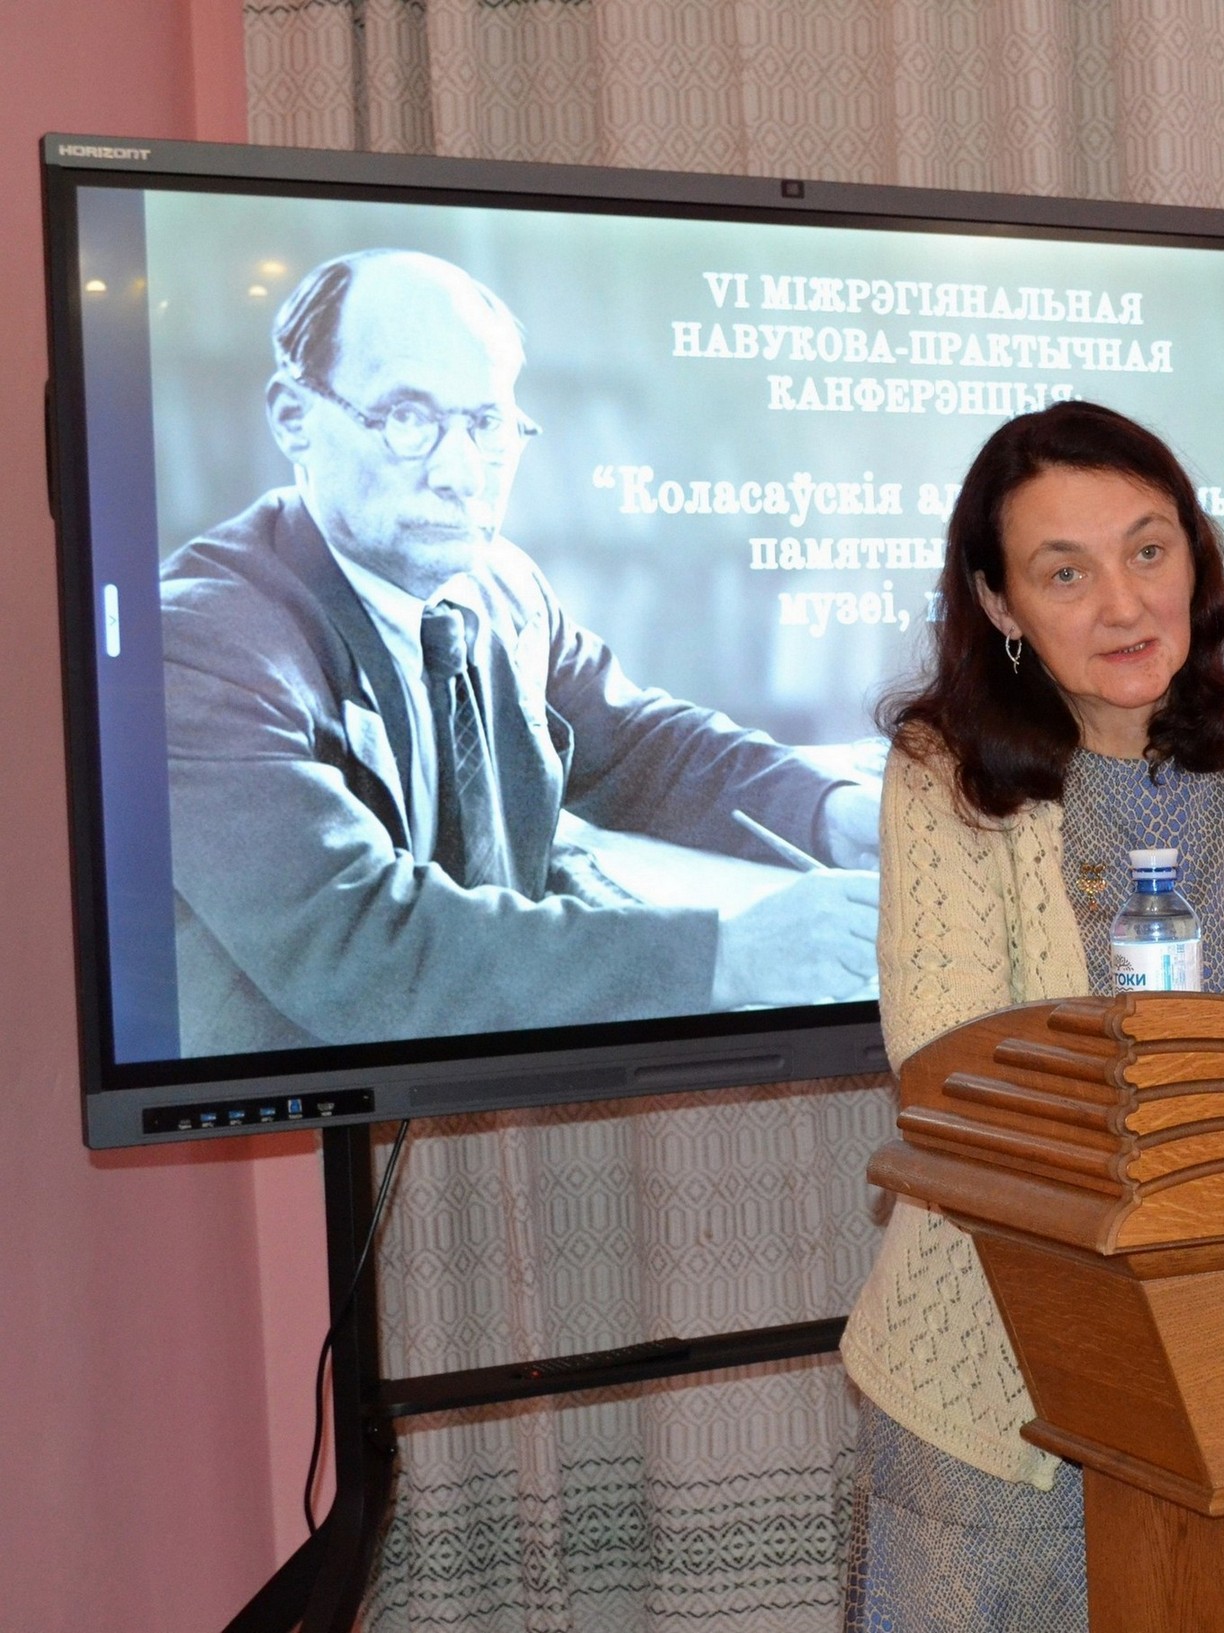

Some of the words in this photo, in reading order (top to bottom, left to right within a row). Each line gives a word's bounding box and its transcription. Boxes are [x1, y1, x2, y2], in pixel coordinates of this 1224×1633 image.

[702, 271, 750, 309] VI
[760, 274, 1144, 325] МІЖРЭГІЯНАЛЬНАЯ
[671, 320, 1174, 373] НАВУКОВА-ПРАКТЫЧНАЯ
